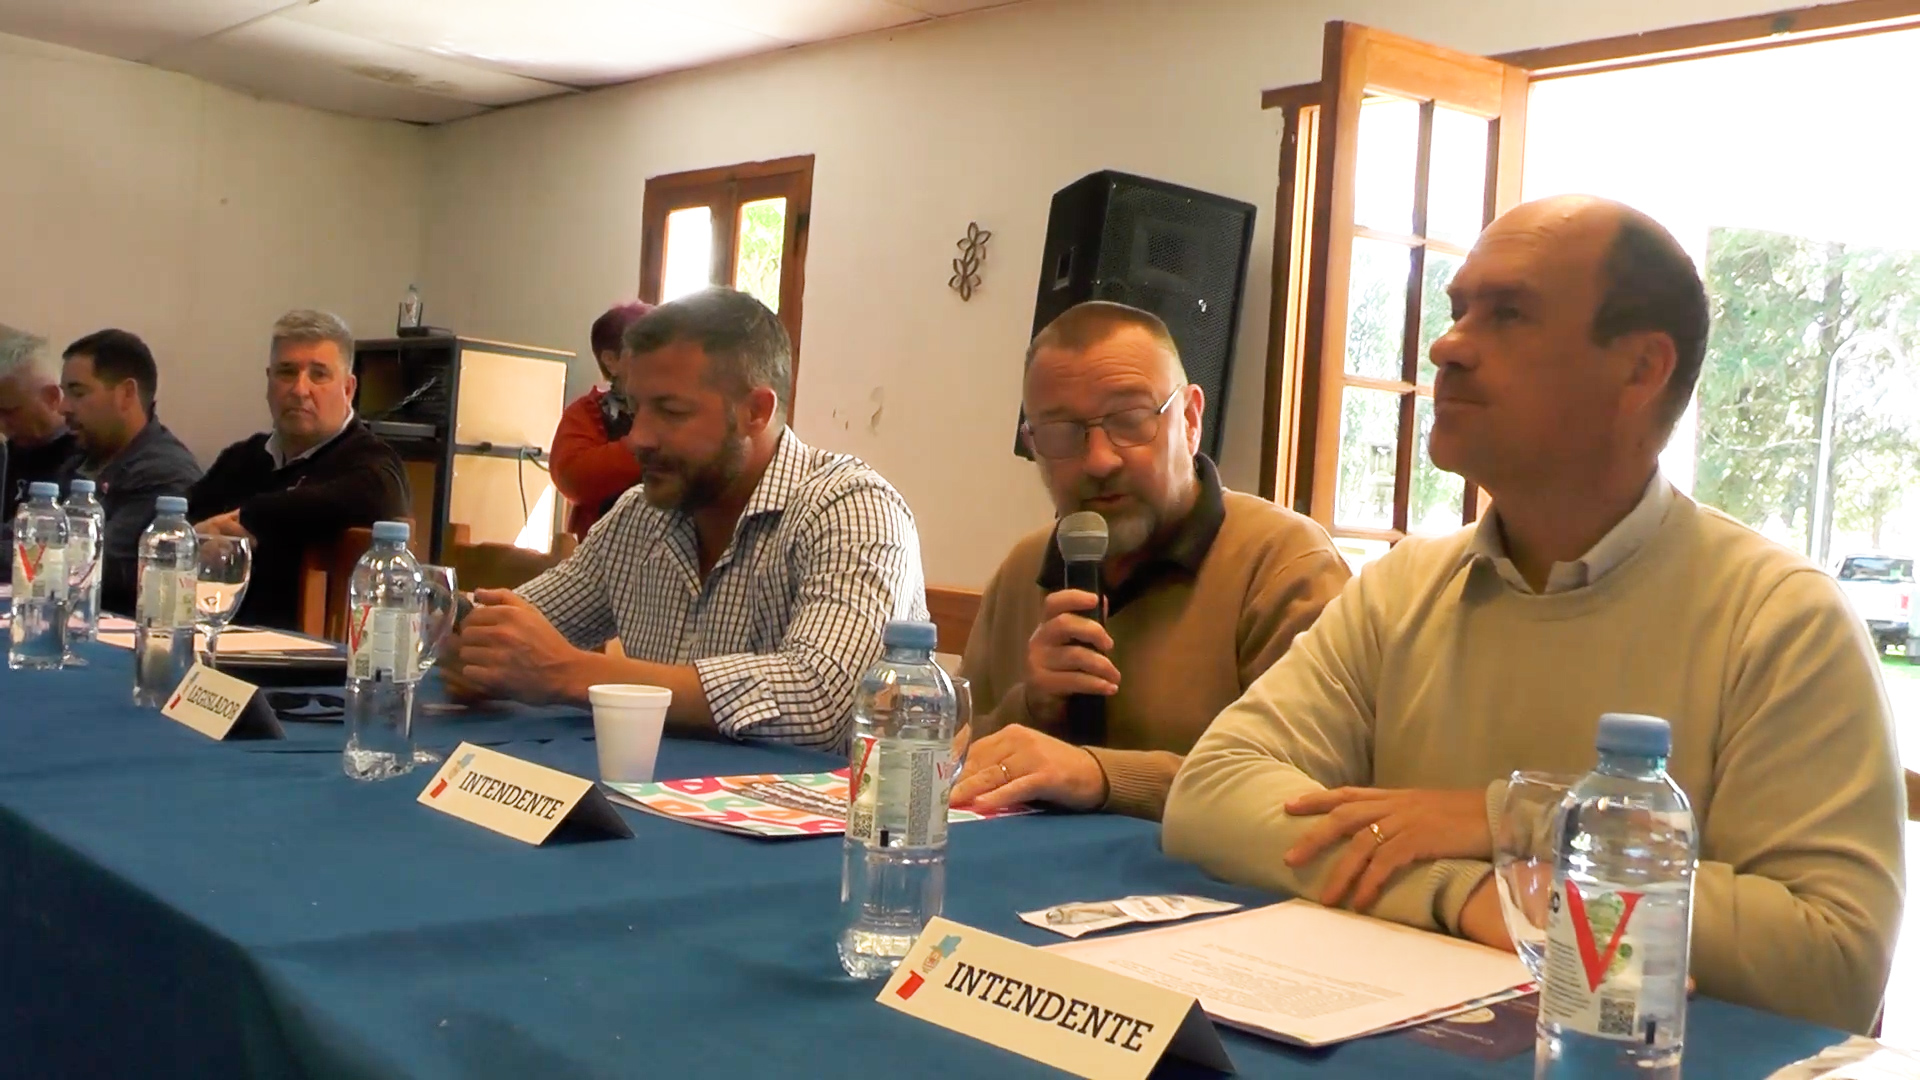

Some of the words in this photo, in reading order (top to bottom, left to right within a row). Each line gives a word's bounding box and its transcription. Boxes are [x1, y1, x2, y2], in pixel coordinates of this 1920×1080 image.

[187, 685, 240, 720] LEGISLADOR
[459, 771, 564, 820] INTENDENTE
[944, 961, 1154, 1053] INTENDENTE
